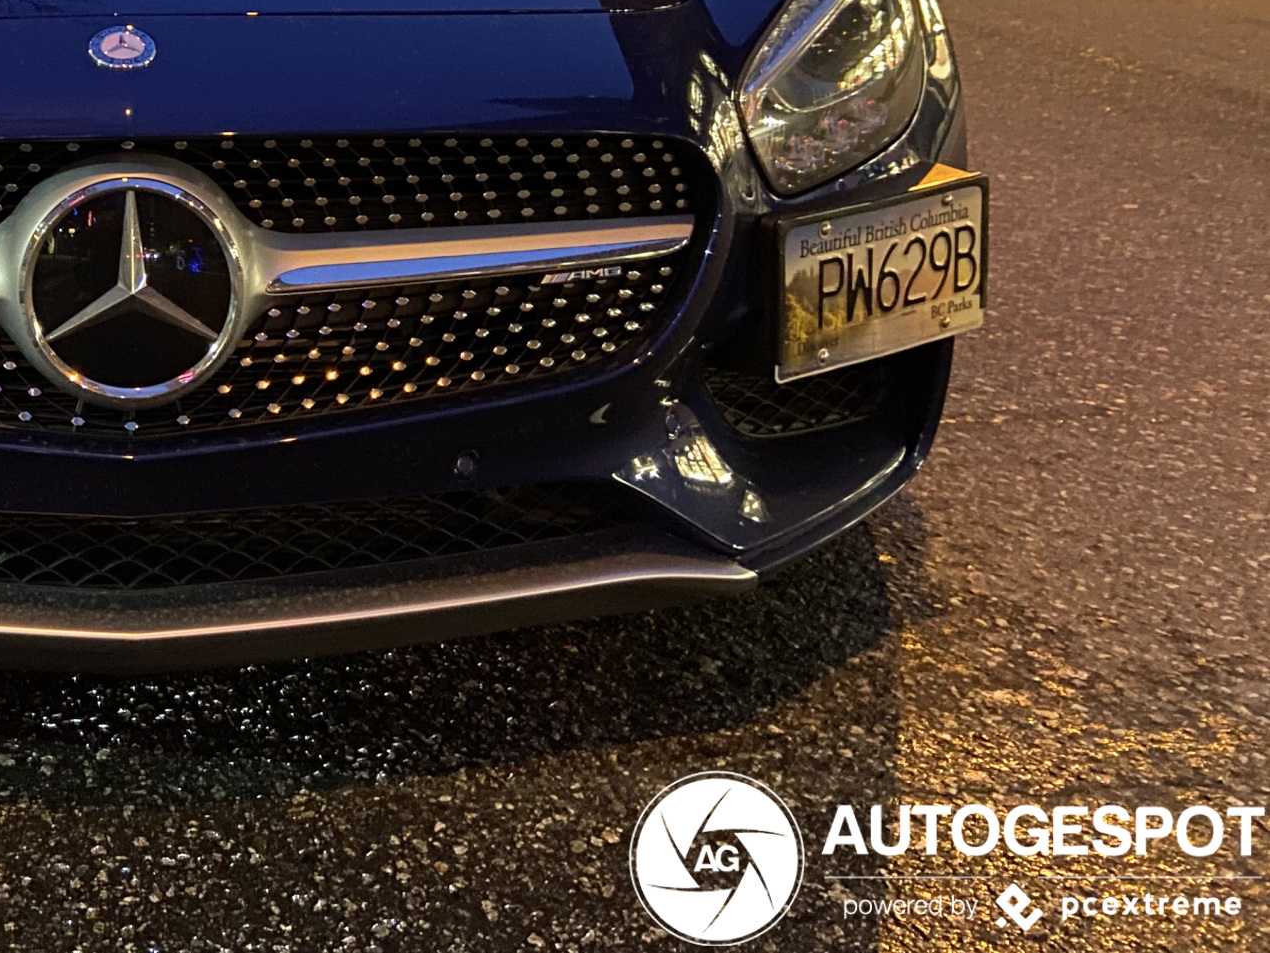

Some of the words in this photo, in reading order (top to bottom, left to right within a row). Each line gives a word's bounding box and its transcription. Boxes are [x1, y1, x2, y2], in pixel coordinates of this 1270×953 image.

[799, 232, 862, 259] Beautiful
[864, 223, 907, 244] British
[909, 204, 969, 232] Columbia
[567, 266, 621, 282] AMG
[817, 223, 978, 330] PW629B
[930, 303, 945, 319] BC
[946, 298, 973, 314] Parks
